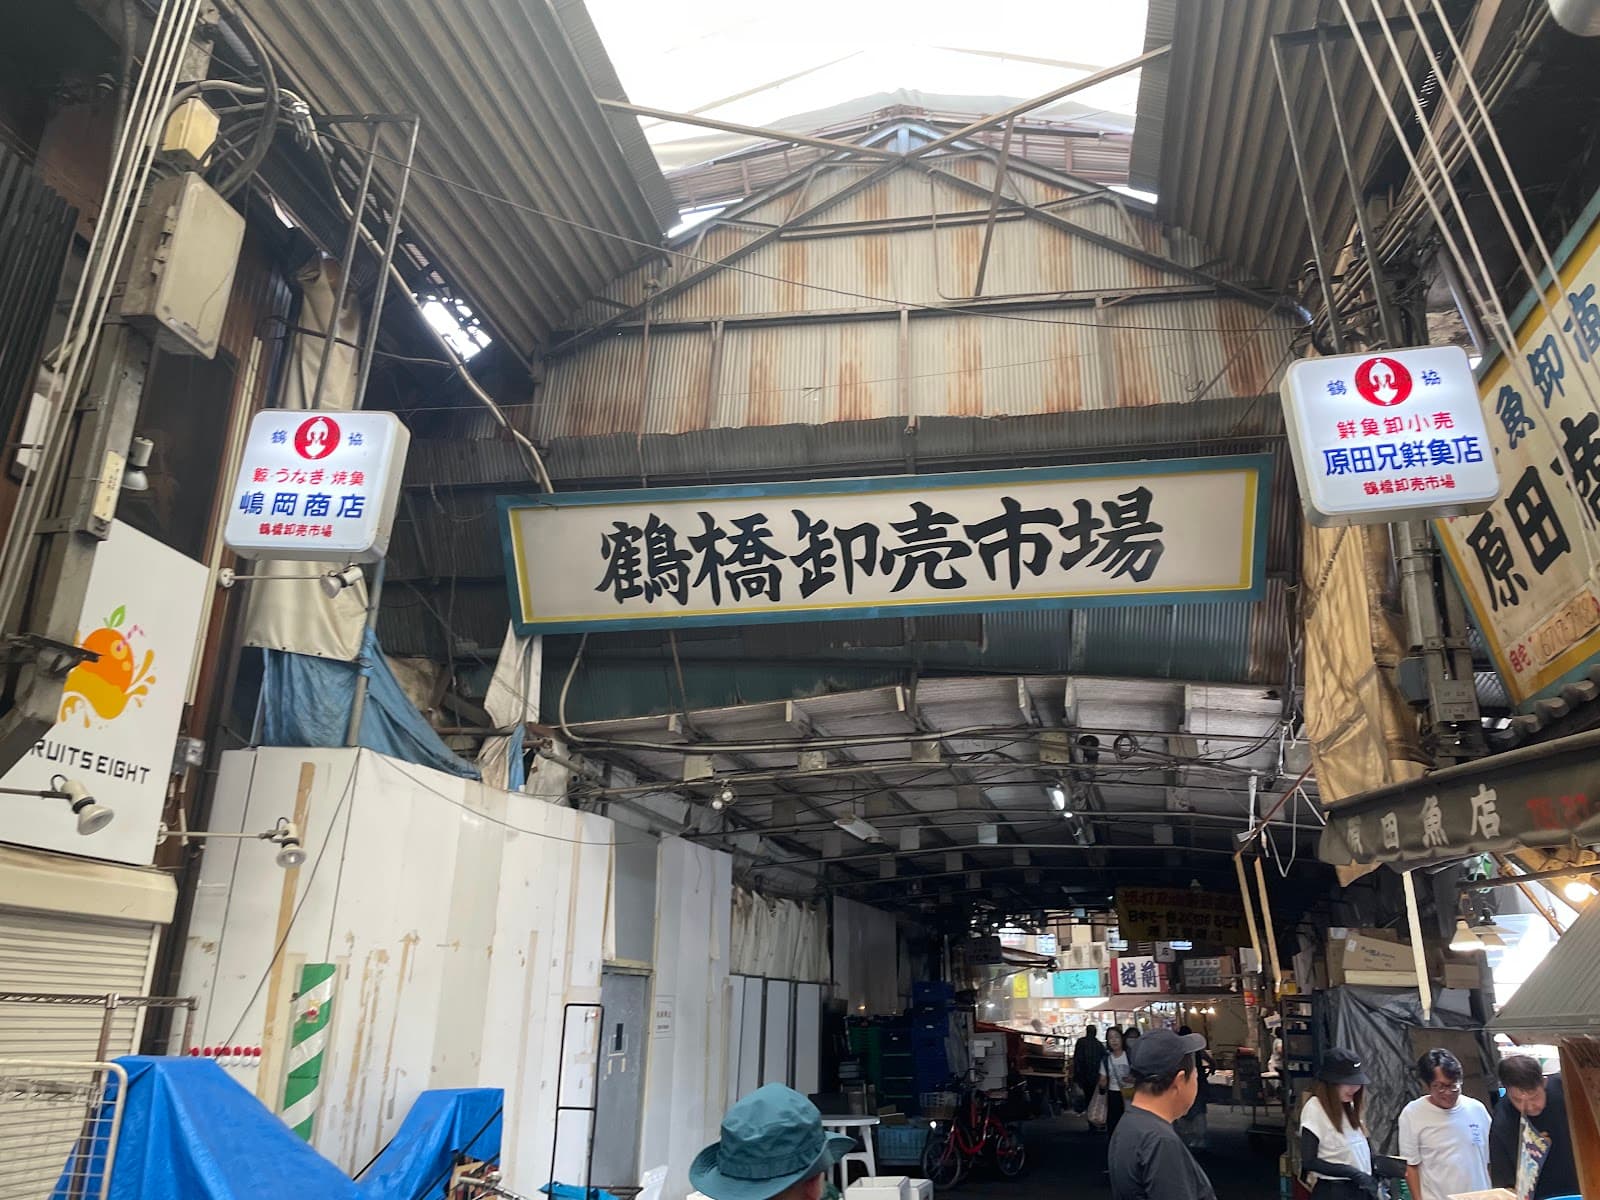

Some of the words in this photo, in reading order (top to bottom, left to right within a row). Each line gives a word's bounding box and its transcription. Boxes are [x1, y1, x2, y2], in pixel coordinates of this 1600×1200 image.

[1495, 283, 1600, 452] 魚卸商
[1336, 411, 1454, 439] 鮮魚卸小売
[1322, 435, 1484, 476] 原田兄鮮魚店
[1363, 473, 1456, 495] 鶴橋卸売市場
[239, 491, 366, 519] 嶋岡商店
[258, 522, 334, 537] 鶴橋卸売市場
[594, 486, 1164, 606] 鶴橋卸売市場
[31, 739, 94, 769] RUITS
